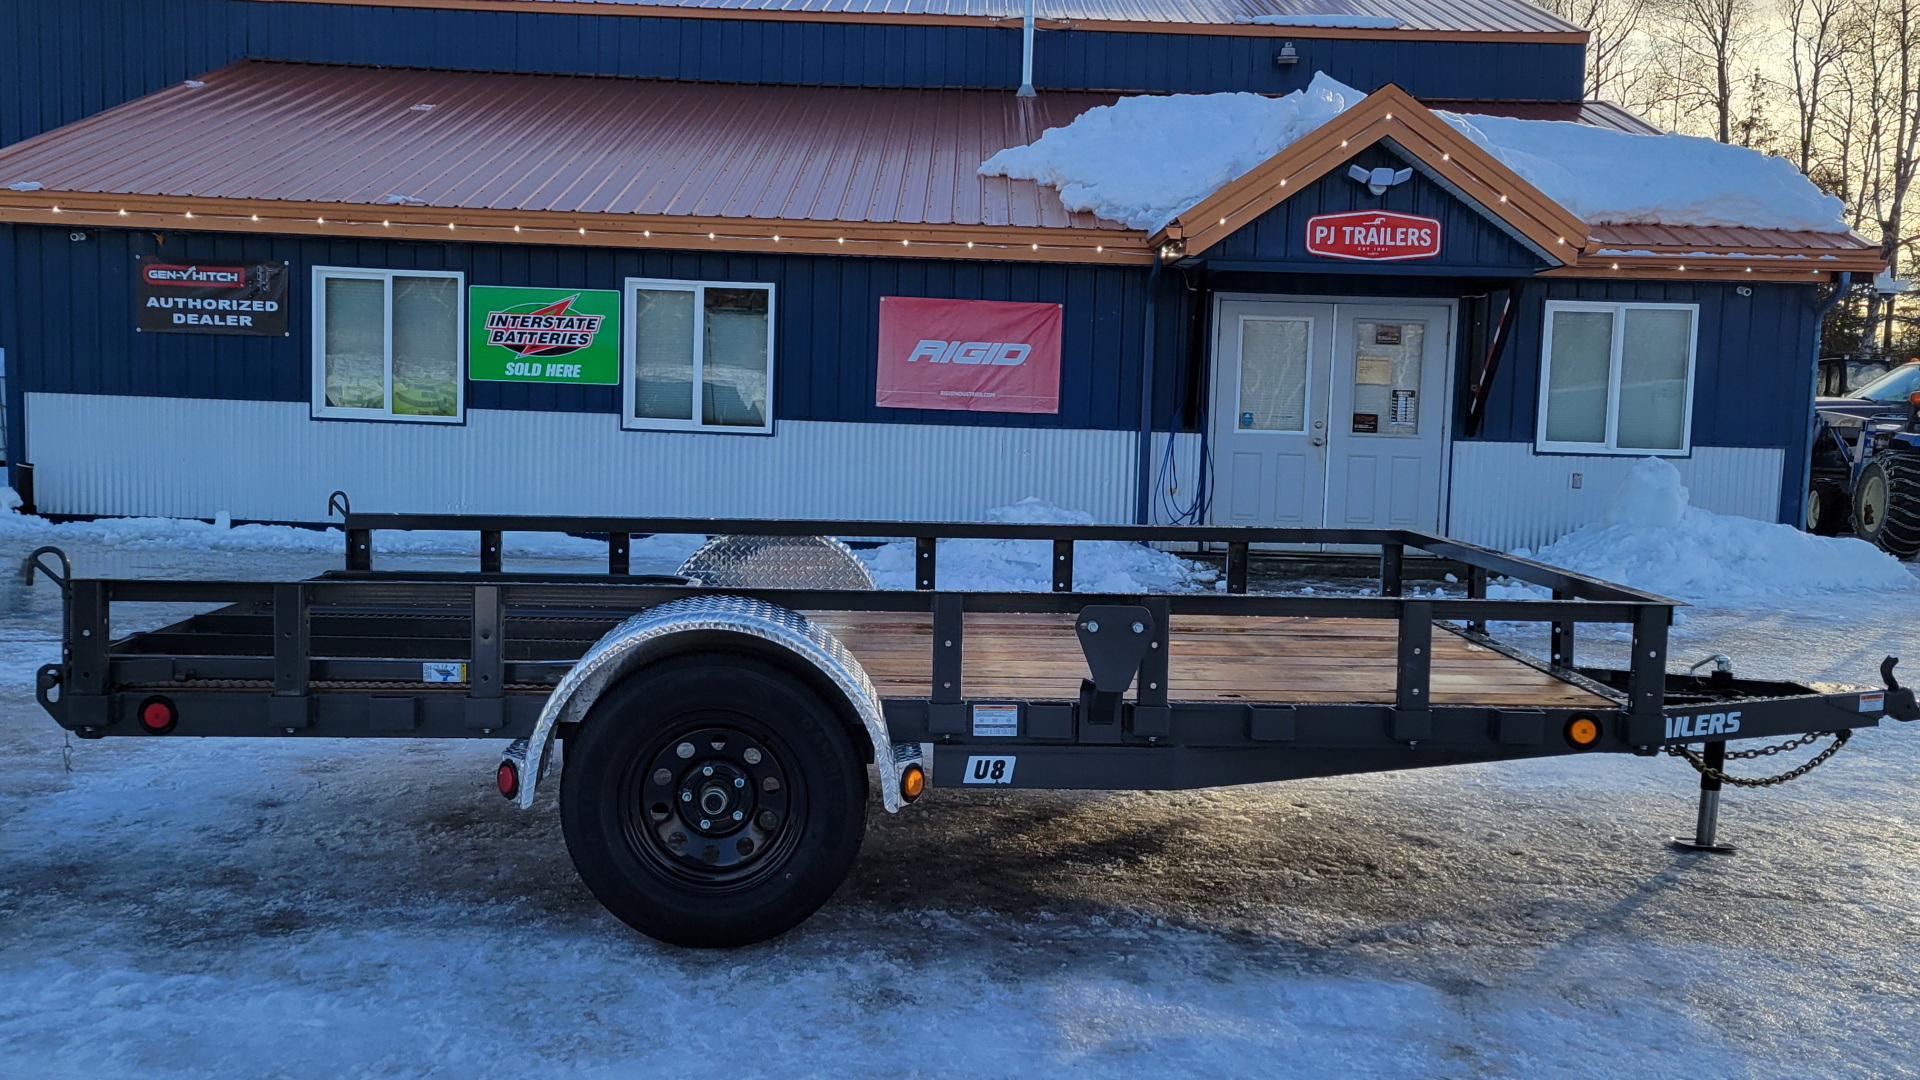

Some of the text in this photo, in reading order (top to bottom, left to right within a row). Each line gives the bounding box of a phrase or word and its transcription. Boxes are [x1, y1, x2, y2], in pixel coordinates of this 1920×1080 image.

[1315, 226, 1432, 247] PJ TRAILERS
[146, 296, 279, 312] AUTHORIZED
[172, 313, 253, 326] DEALER
[489, 315, 598, 331] INTERSTATE
[492, 331, 592, 345] BATTERIES
[907, 339, 1032, 366] RIGID
[505, 362, 582, 378] SOLD HERE
[974, 760, 1006, 780] U8
